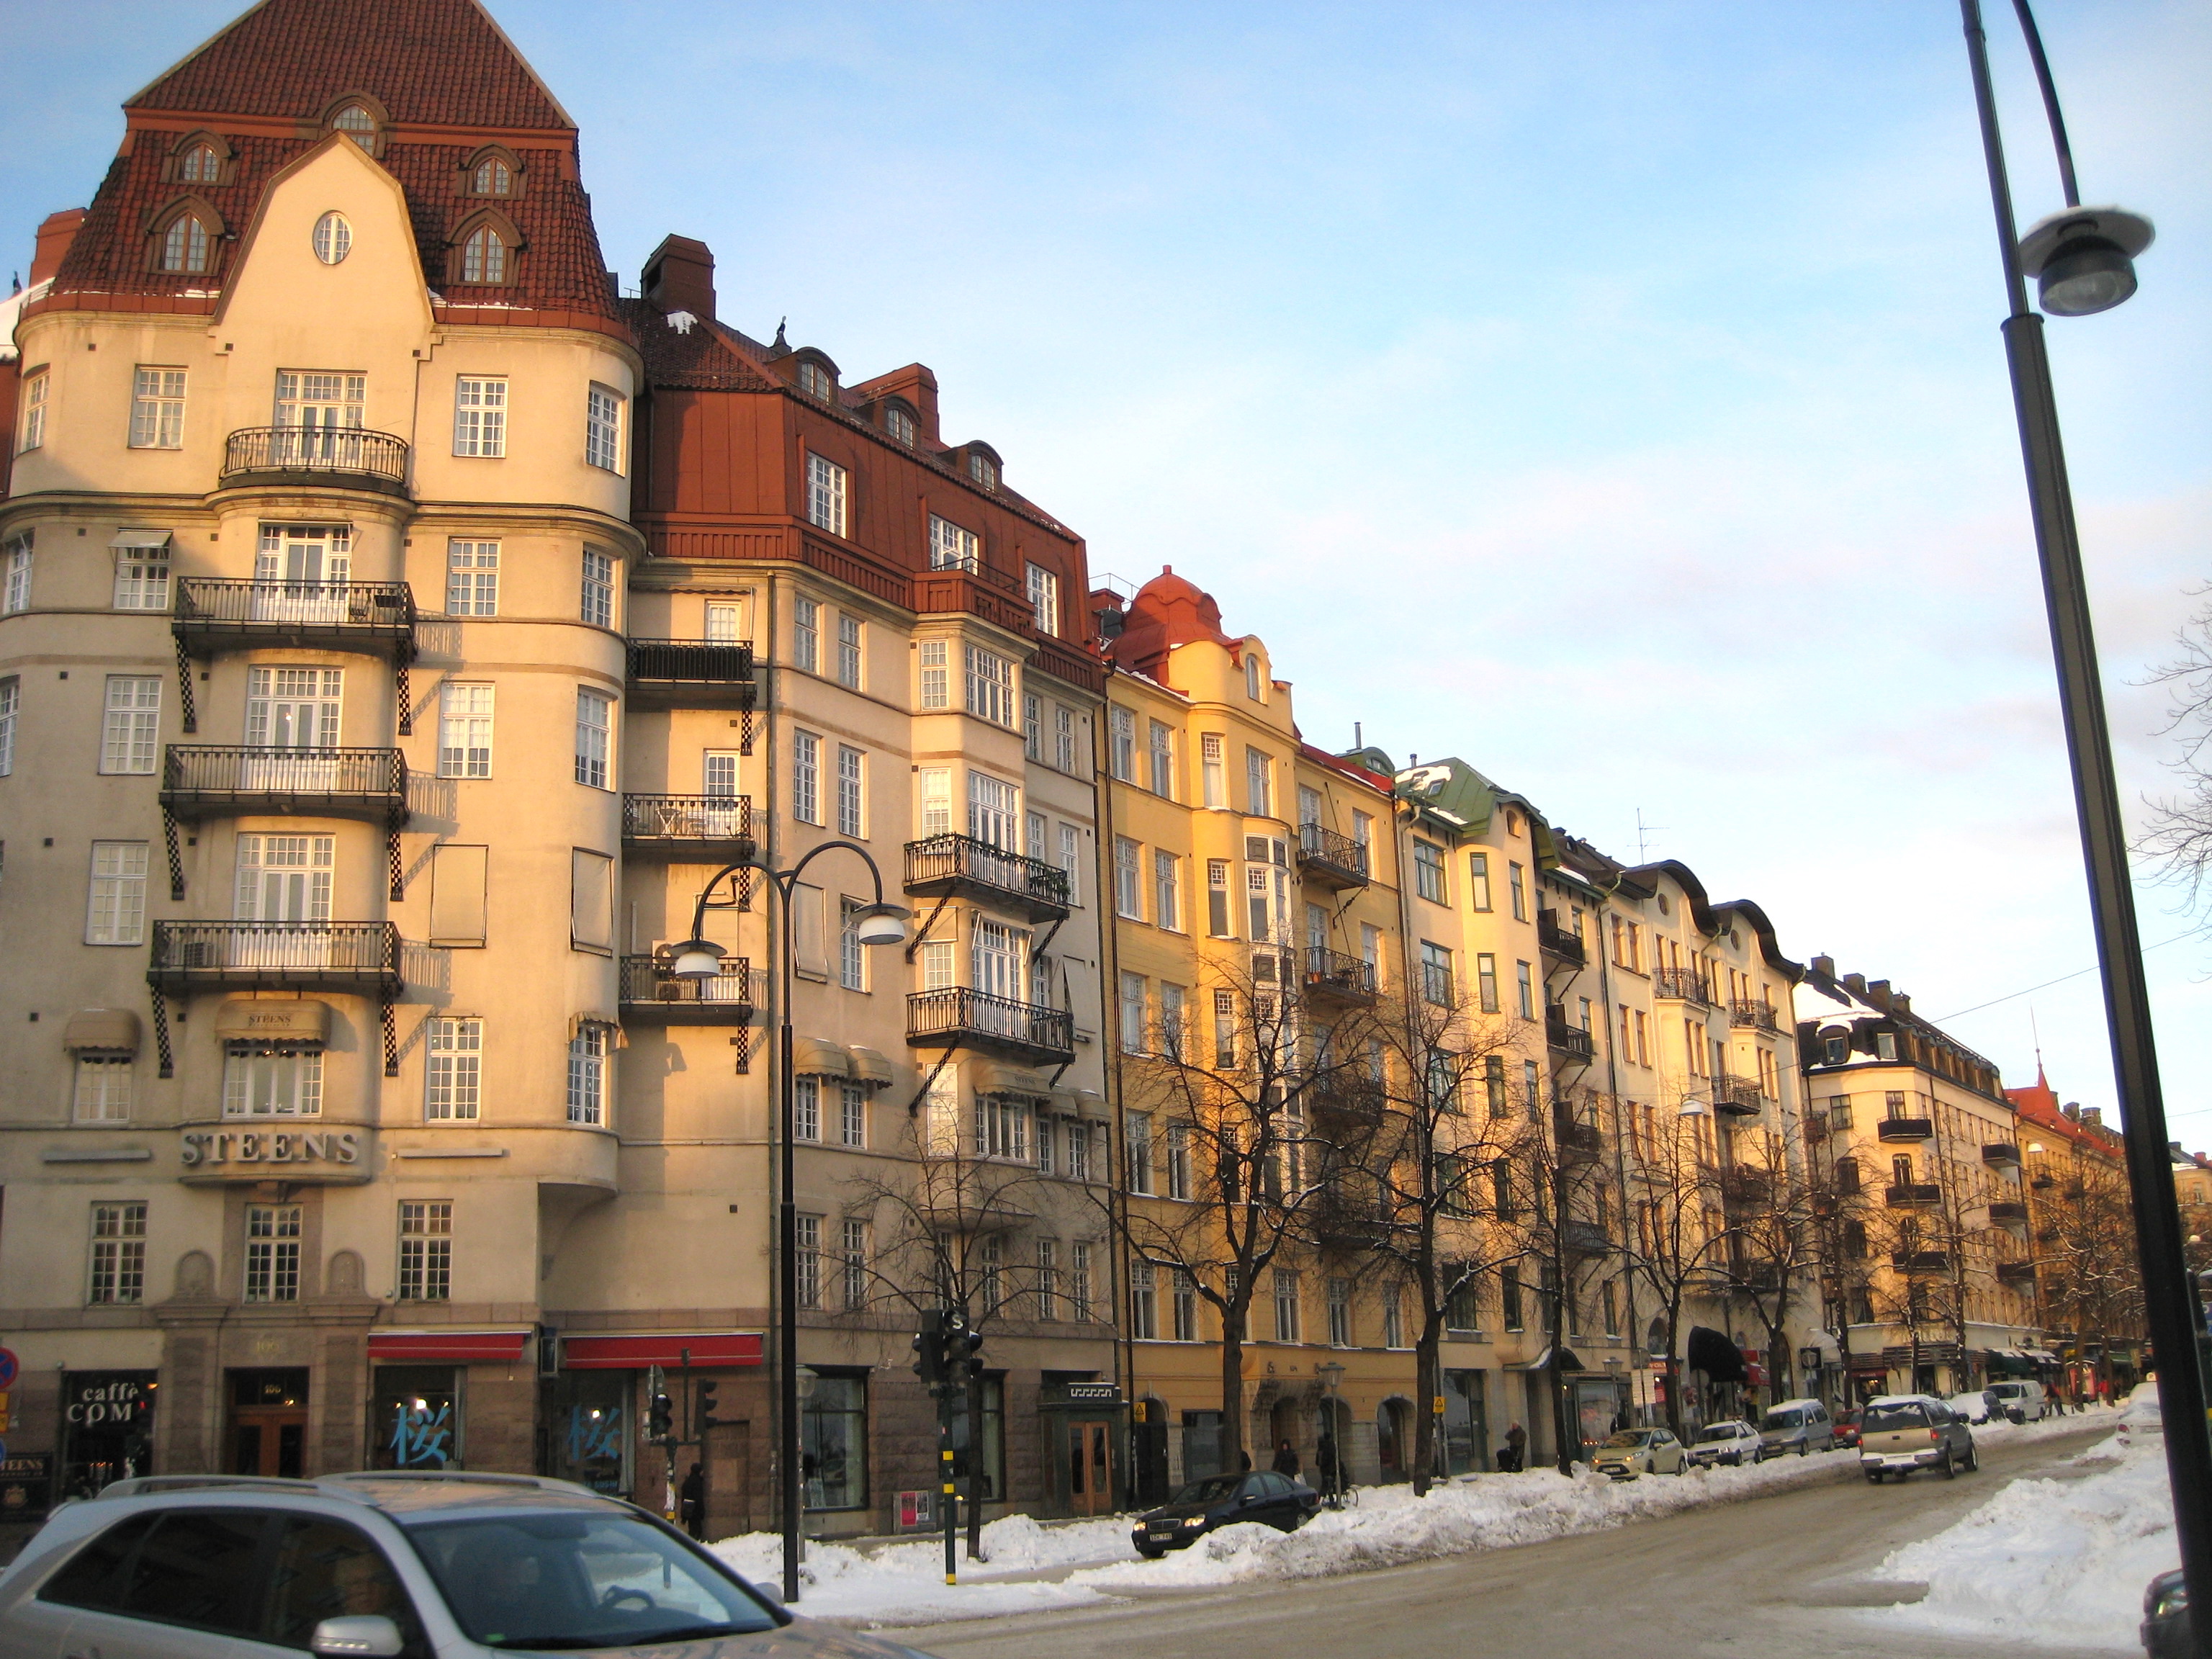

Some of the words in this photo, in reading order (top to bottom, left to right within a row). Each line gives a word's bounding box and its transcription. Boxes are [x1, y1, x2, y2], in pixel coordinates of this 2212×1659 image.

[248, 1014, 291, 1023] STEENS
[181, 1132, 359, 1164] STEENS
[389, 1405, 451, 1465] 桜
[565, 1405, 621, 1461] 桜
